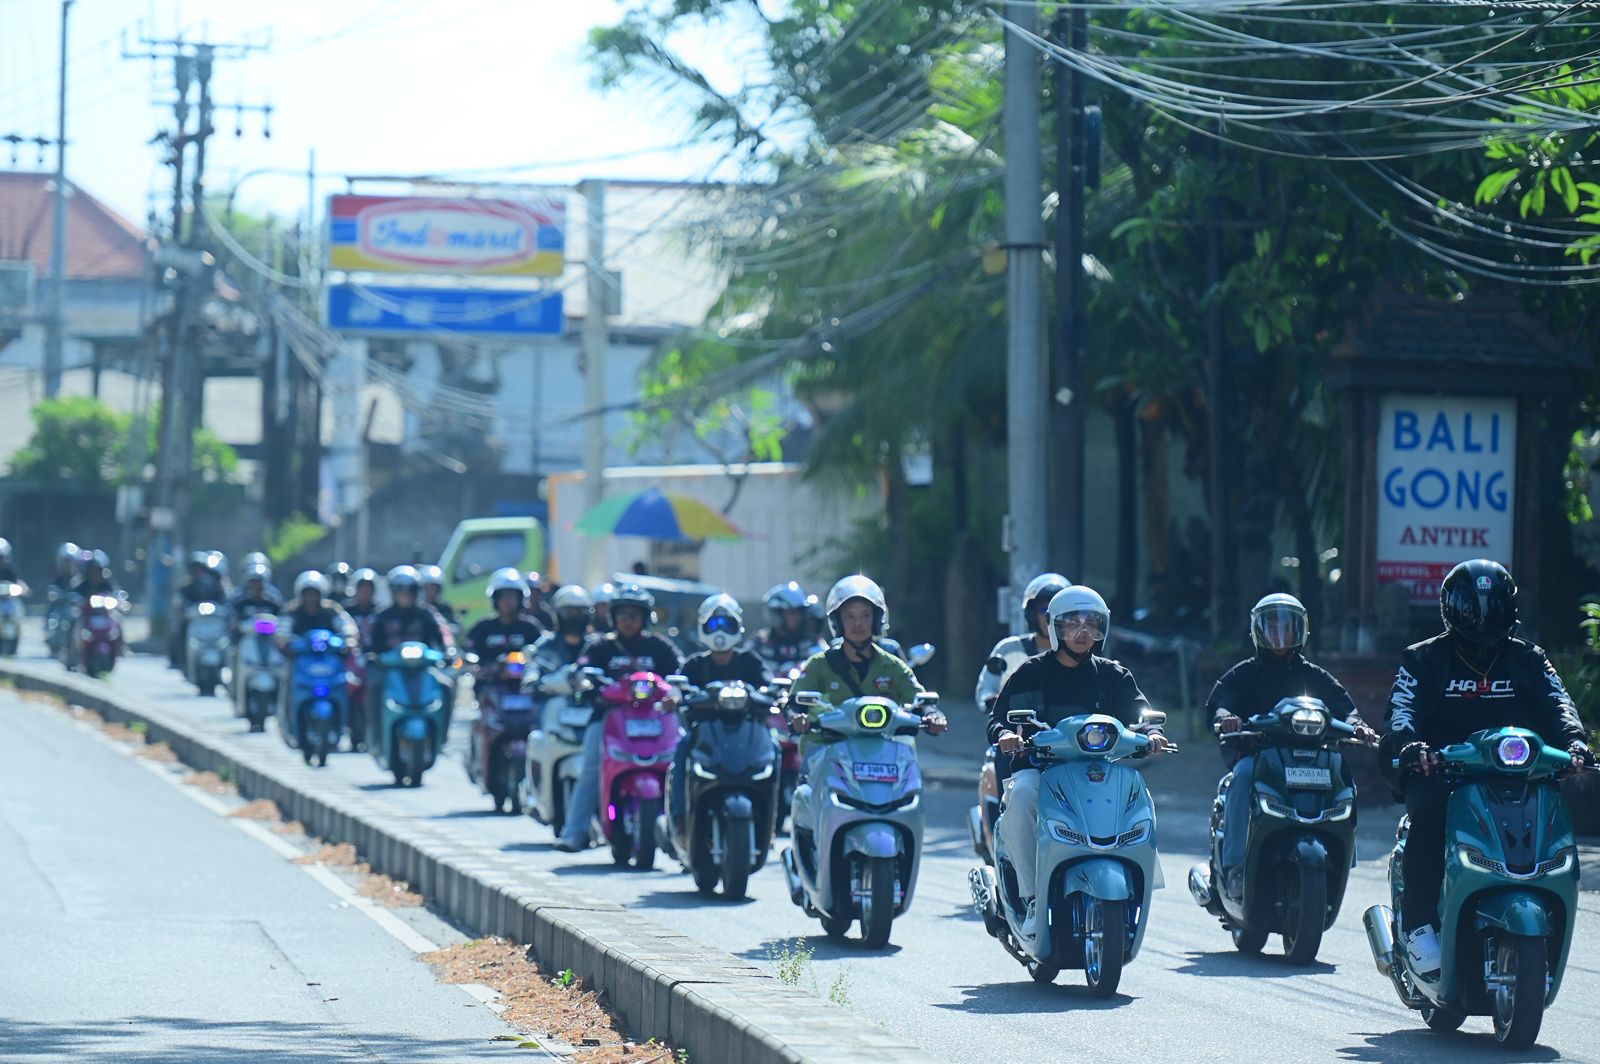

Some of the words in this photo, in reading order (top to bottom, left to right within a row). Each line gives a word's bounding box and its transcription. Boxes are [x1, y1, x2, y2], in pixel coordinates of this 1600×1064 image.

[1393, 410, 1499, 454] BALI
[1384, 467, 1508, 513] GONG
[1400, 525, 1489, 547] ANTIK
[1287, 768, 1297, 777] DK
